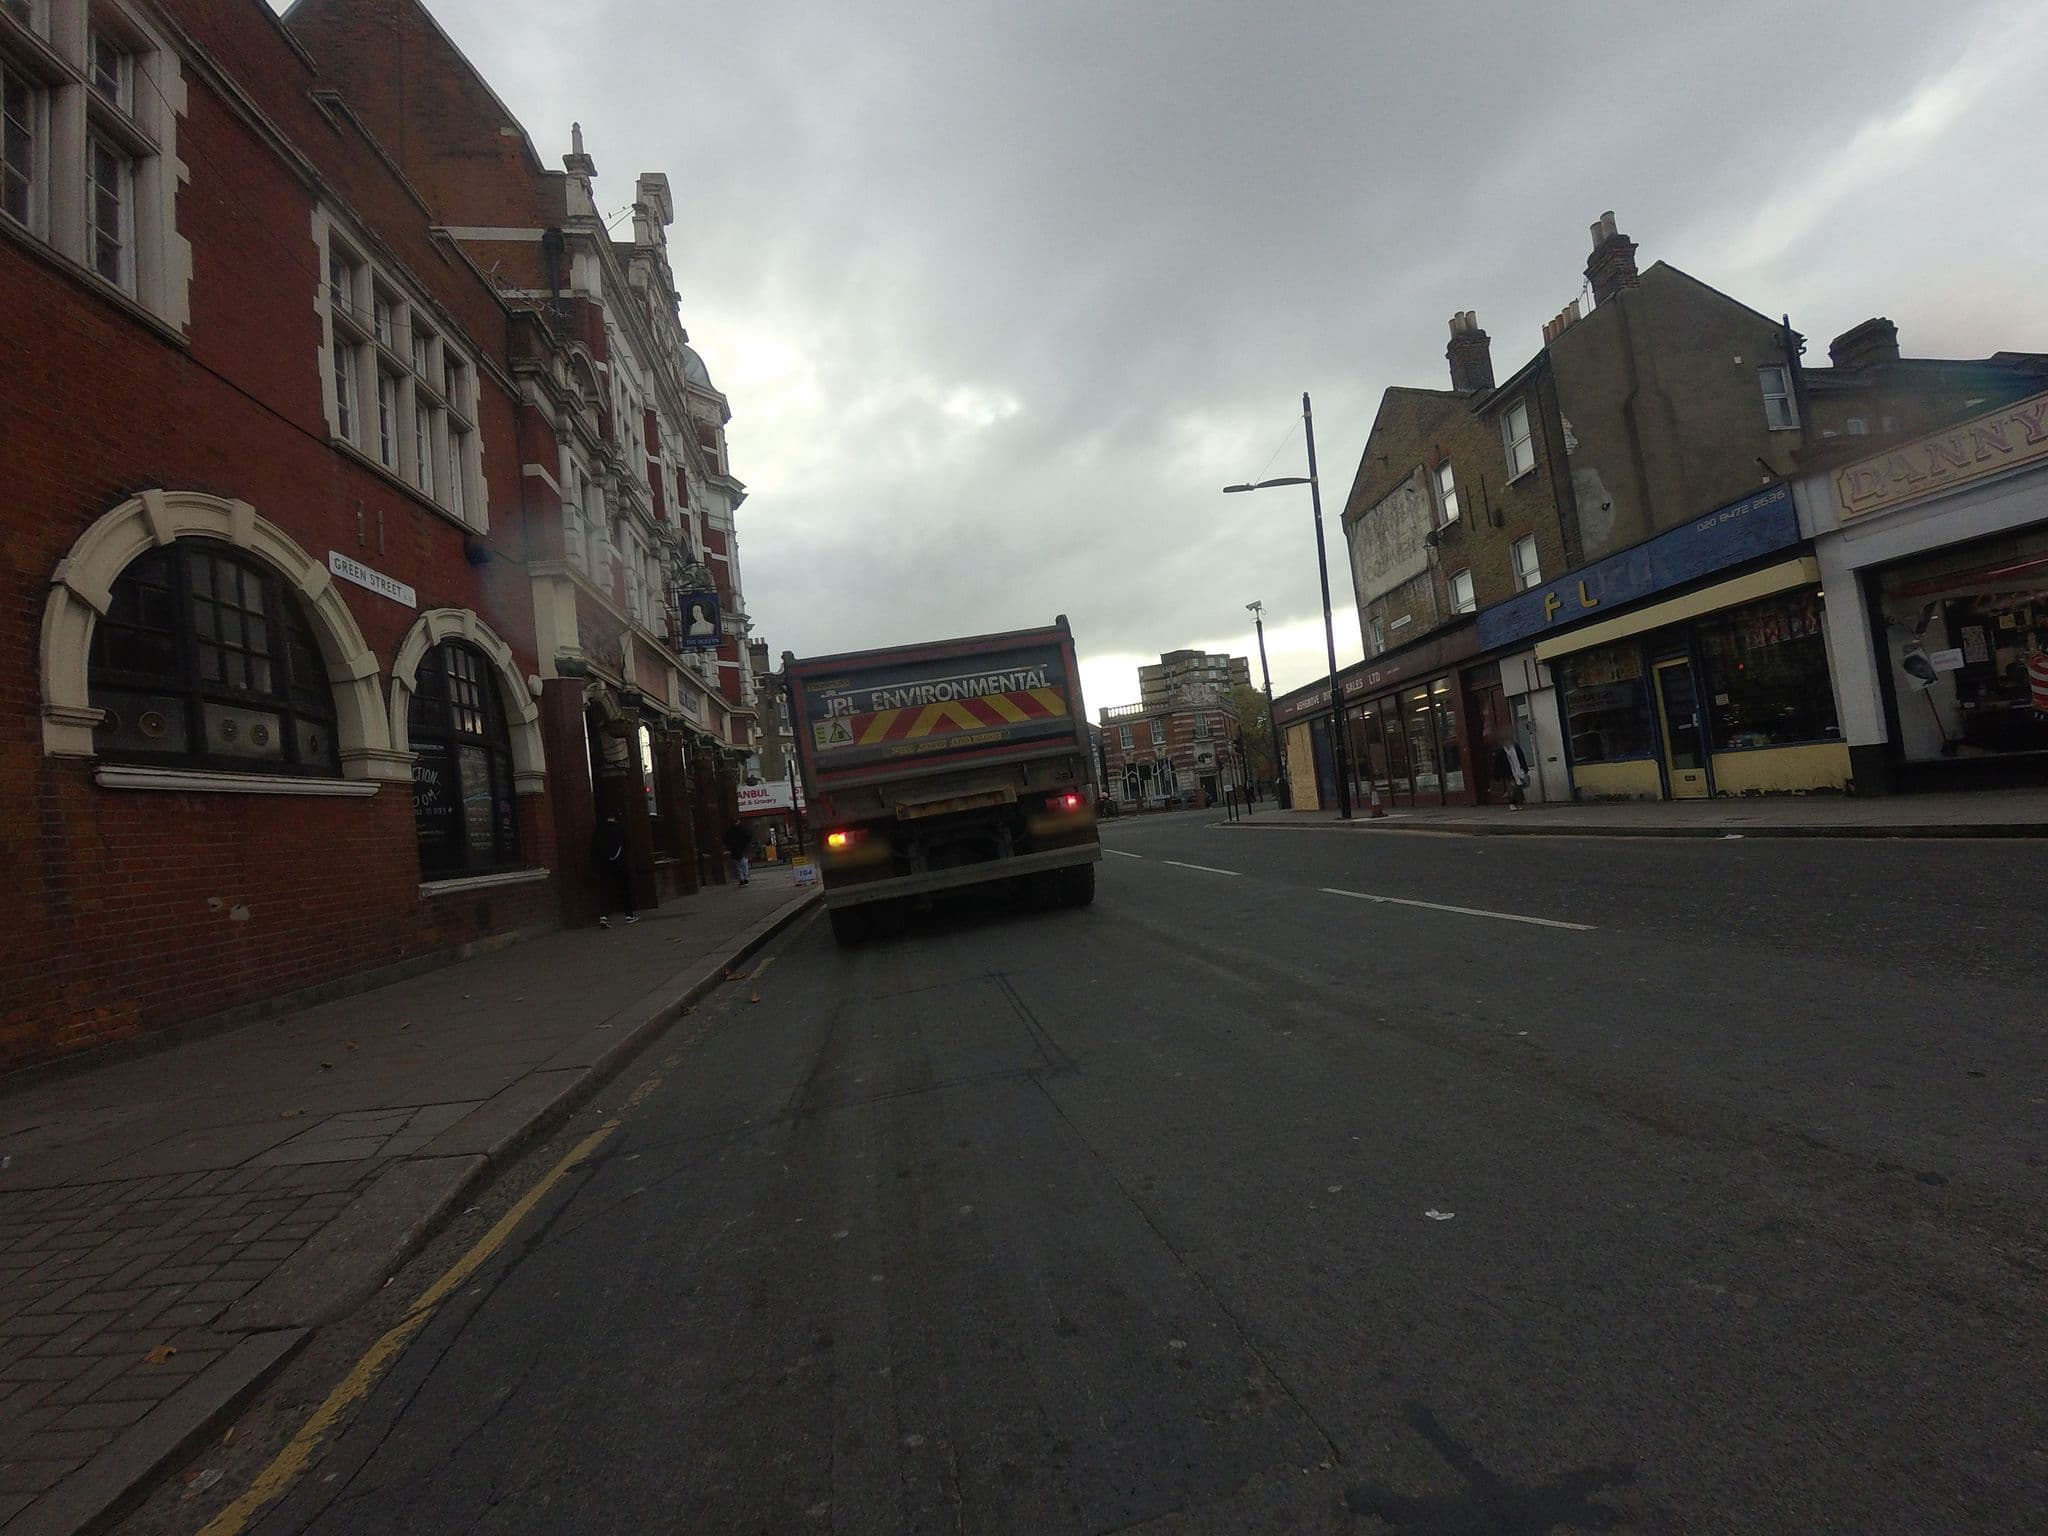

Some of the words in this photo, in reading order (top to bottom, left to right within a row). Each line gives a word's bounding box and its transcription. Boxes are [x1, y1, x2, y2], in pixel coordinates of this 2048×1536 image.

[1696, 518, 1717, 532] 020
[1719, 504, 1751, 522] 8472
[1752, 489, 1785, 510] 2636
[334, 557, 367, 582] GREEN
[370, 573, 402, 598] STREET
[823, 696, 862, 719] JPL
[871, 669, 1052, 712] ENVIRONMENTAL
[1345, 678, 1364, 694] SALES
[1368, 671, 1381, 686] LTD
